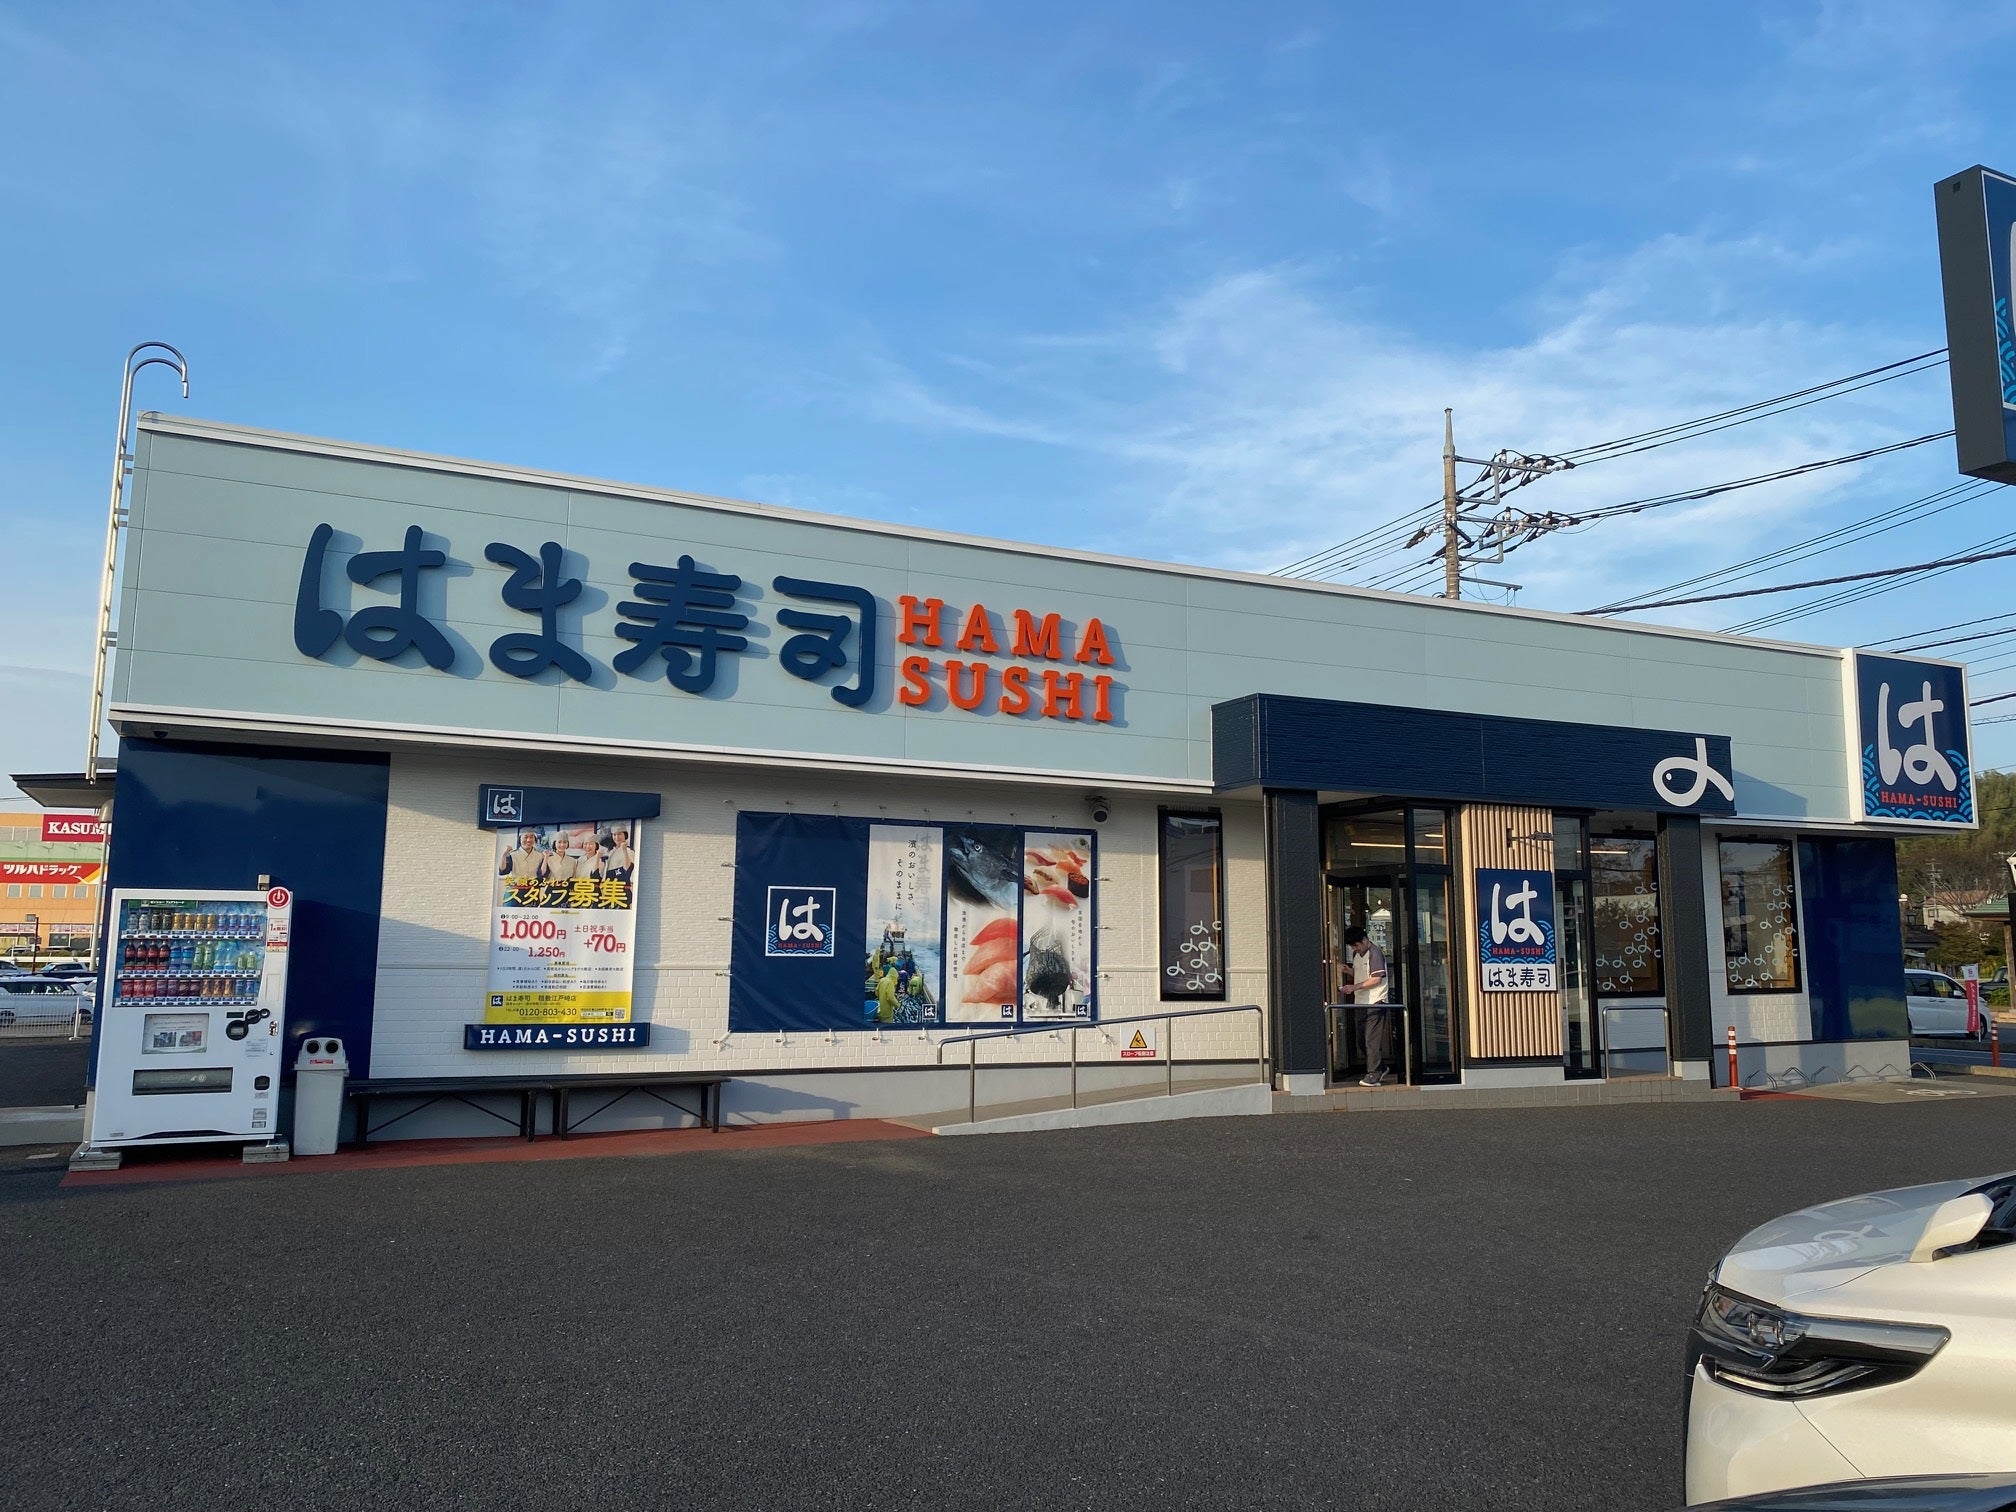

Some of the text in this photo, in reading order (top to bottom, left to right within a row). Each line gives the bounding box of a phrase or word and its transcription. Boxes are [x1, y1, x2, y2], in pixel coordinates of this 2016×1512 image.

[293, 522, 877, 708] はま寿司
[897, 594, 1116, 665] HAMA
[898, 655, 1114, 722] SUSHI
[1877, 680, 1958, 792] は
[493, 793, 517, 815] は
[1880, 791, 1958, 809] HAMA-SUSHI
[3, 864, 81, 876] ツルハドラッグ
[502, 878, 628, 909] スタッフ募集
[895, 858, 904, 911] そのままに
[778, 896, 824, 942] は
[1490, 879, 1546, 946] は
[500, 920, 567, 940] 1,000円
[583, 934, 626, 953] +70円
[777, 942, 823, 950] HAMA-SUSHI
[1491, 947, 1545, 956] HAMA-SUSHI
[1488, 966, 1551, 988] はま寿司
[519, 1007, 577, 1017] 0120-803-430
[480, 1027, 637, 1045] HAMA-SUSHI
